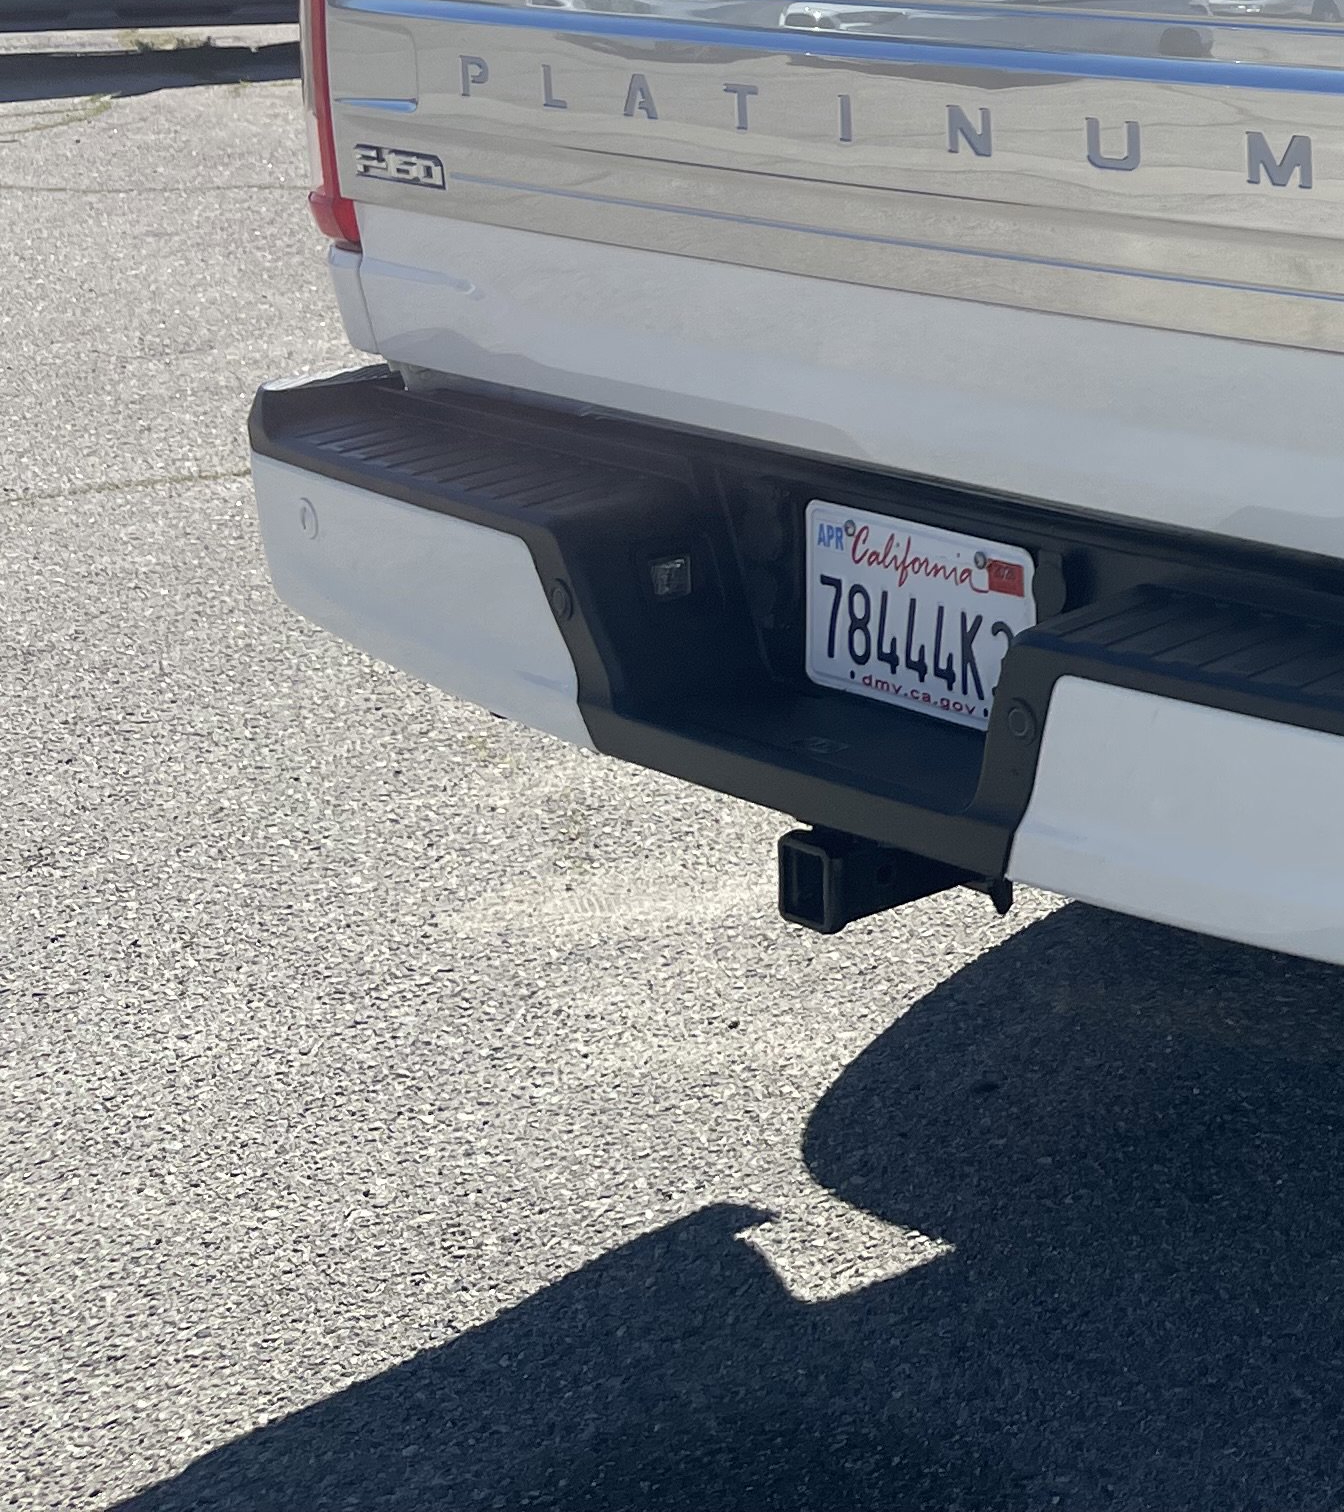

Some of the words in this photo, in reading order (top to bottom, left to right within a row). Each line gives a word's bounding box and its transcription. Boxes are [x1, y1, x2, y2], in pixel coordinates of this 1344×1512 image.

[458, 54, 1314, 190] PLATINUM
[817, 523, 844, 551] APR
[851, 526, 990, 593] California
[861, 673, 976, 716] dmv.ca.gov
